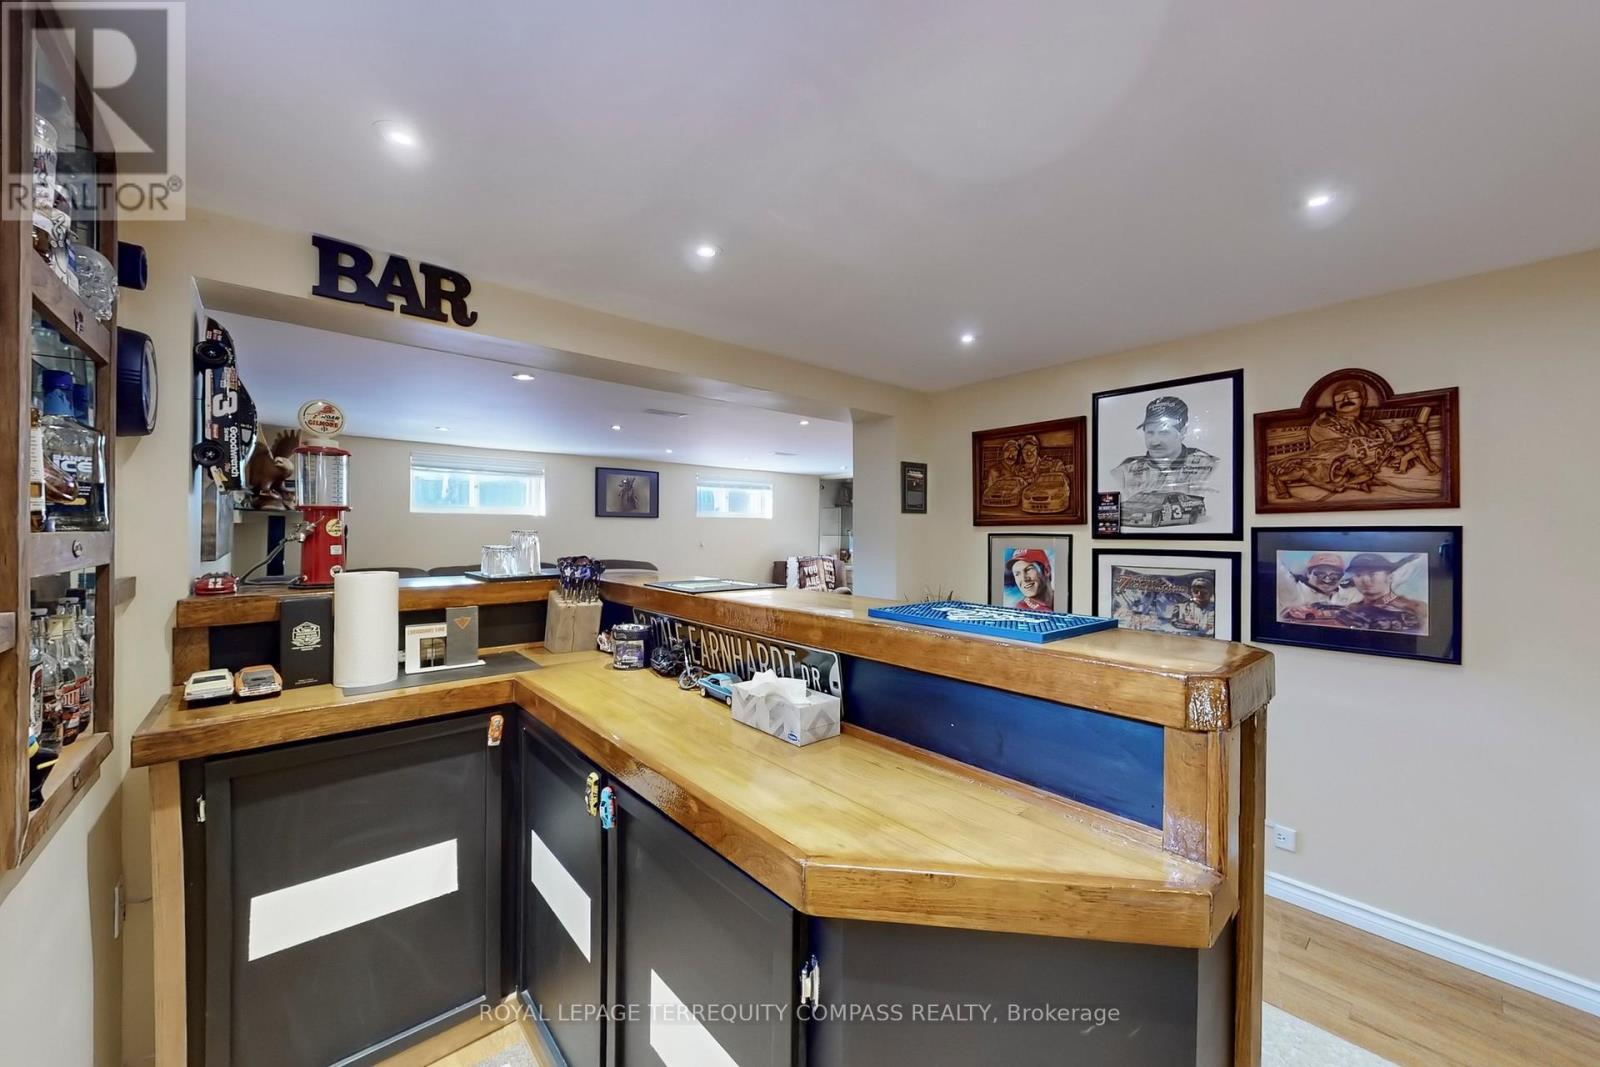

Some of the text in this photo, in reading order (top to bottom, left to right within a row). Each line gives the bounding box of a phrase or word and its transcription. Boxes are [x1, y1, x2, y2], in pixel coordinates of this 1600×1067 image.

[311, 233, 478, 328] BAR
[212, 391, 238, 418] 3
[230, 426, 241, 478] Goodwrench
[1172, 504, 1183, 519] 3
[688, 625, 796, 681] EARNHARDT
[801, 663, 828, 693] DR.
